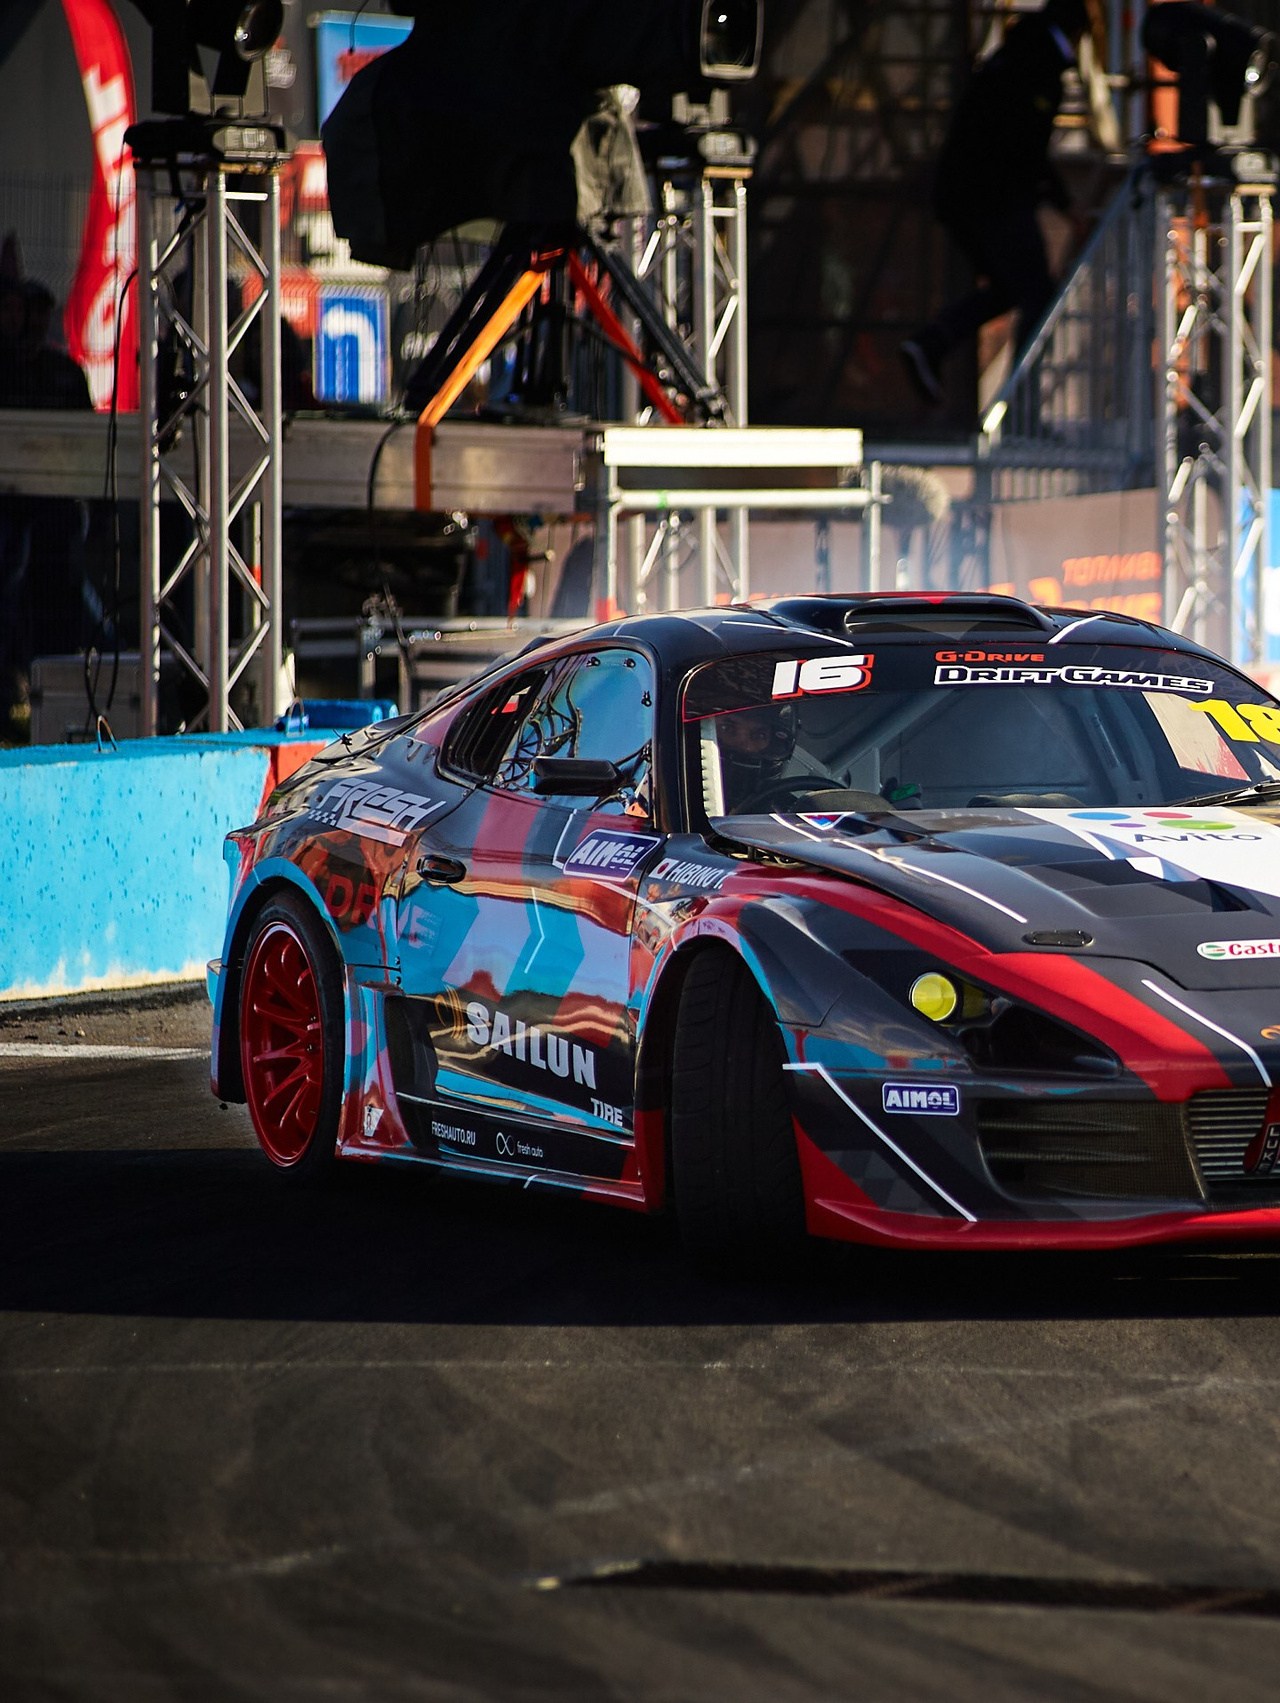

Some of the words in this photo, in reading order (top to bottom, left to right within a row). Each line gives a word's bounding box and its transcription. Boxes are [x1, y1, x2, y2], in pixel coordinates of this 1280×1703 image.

[771, 654, 875, 699] 16
[1134, 832, 1262, 843] Avito
[666, 861, 720, 888] HIBINO
[466, 1001, 597, 1090] SAILUN
[590, 1097, 623, 1127] TIRE
[885, 1090, 955, 1109] AIMOL
[431, 1121, 476, 1146] FRESHAUTO.RU
